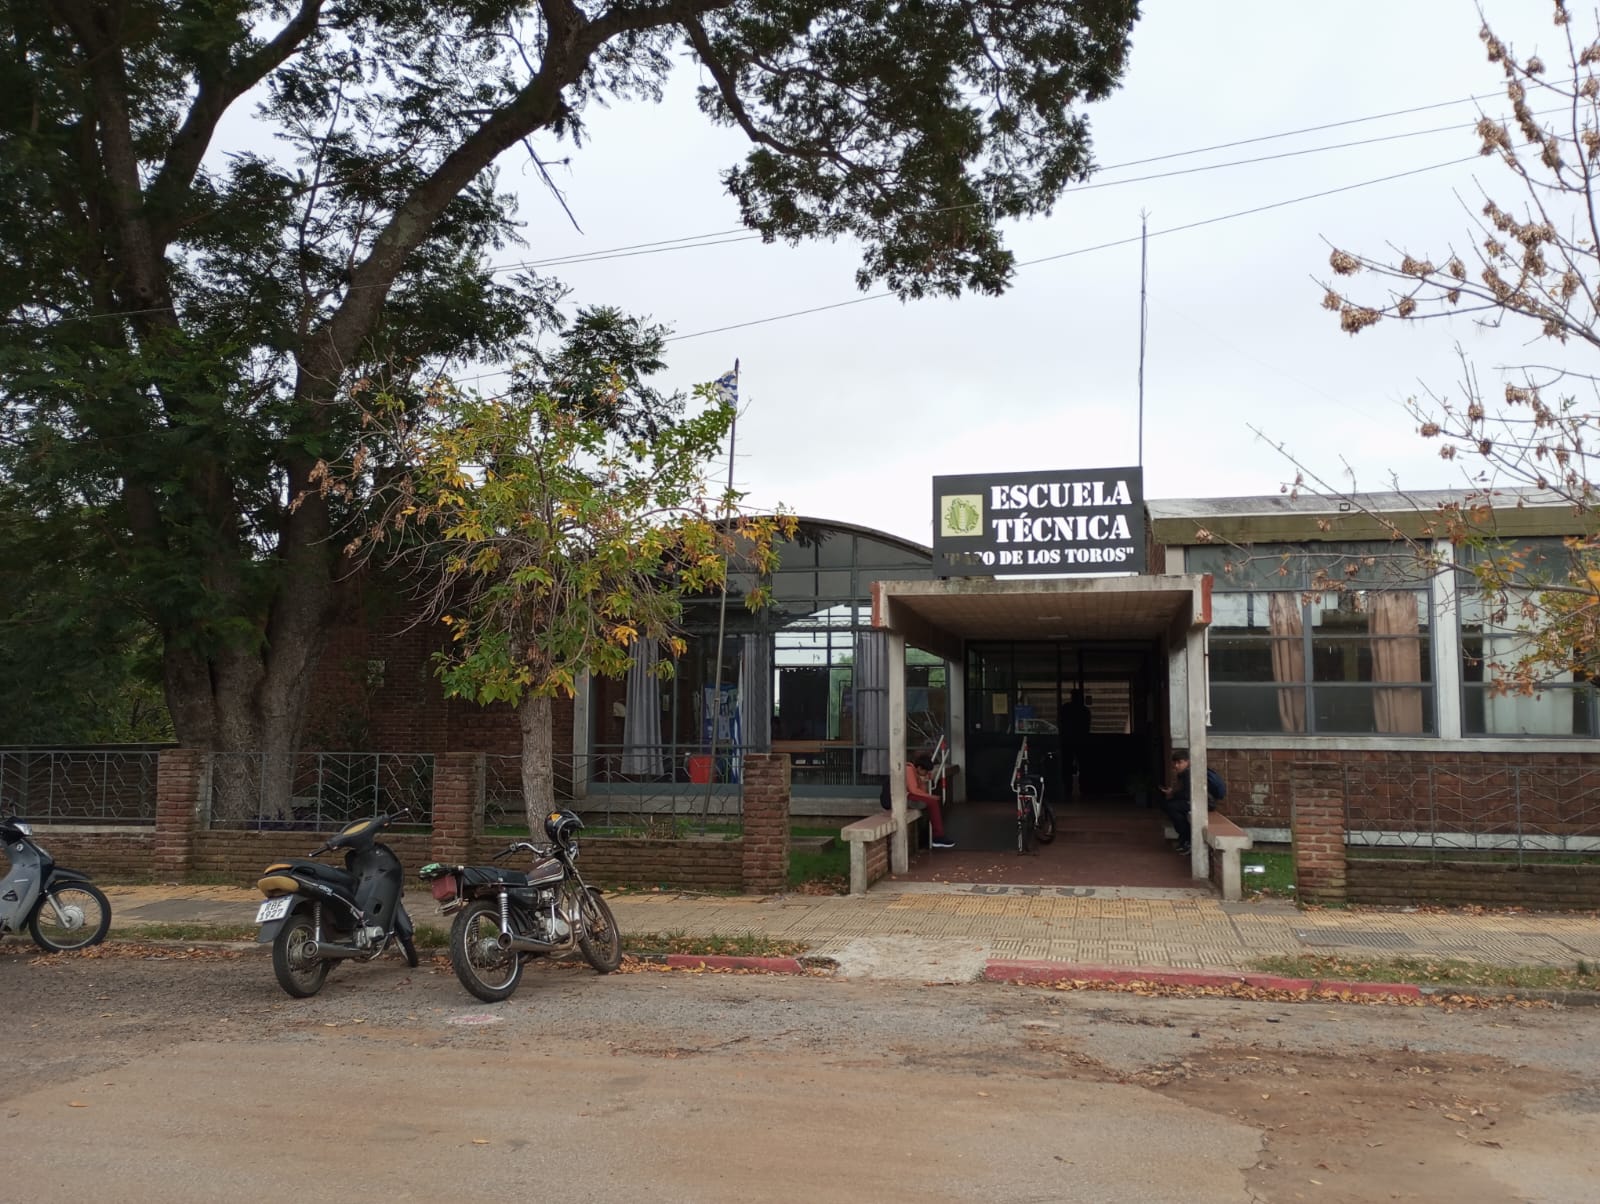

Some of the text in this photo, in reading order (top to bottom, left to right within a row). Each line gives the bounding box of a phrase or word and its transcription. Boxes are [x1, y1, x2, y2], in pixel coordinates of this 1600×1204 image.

[990, 480, 1133, 510] ESCUELA
[992, 512, 1132, 543] TÉCNICA
[999, 550, 1024, 566] DE
[1027, 549, 1061, 565] LOS
[1065, 546, 1135, 564] TOROS"
